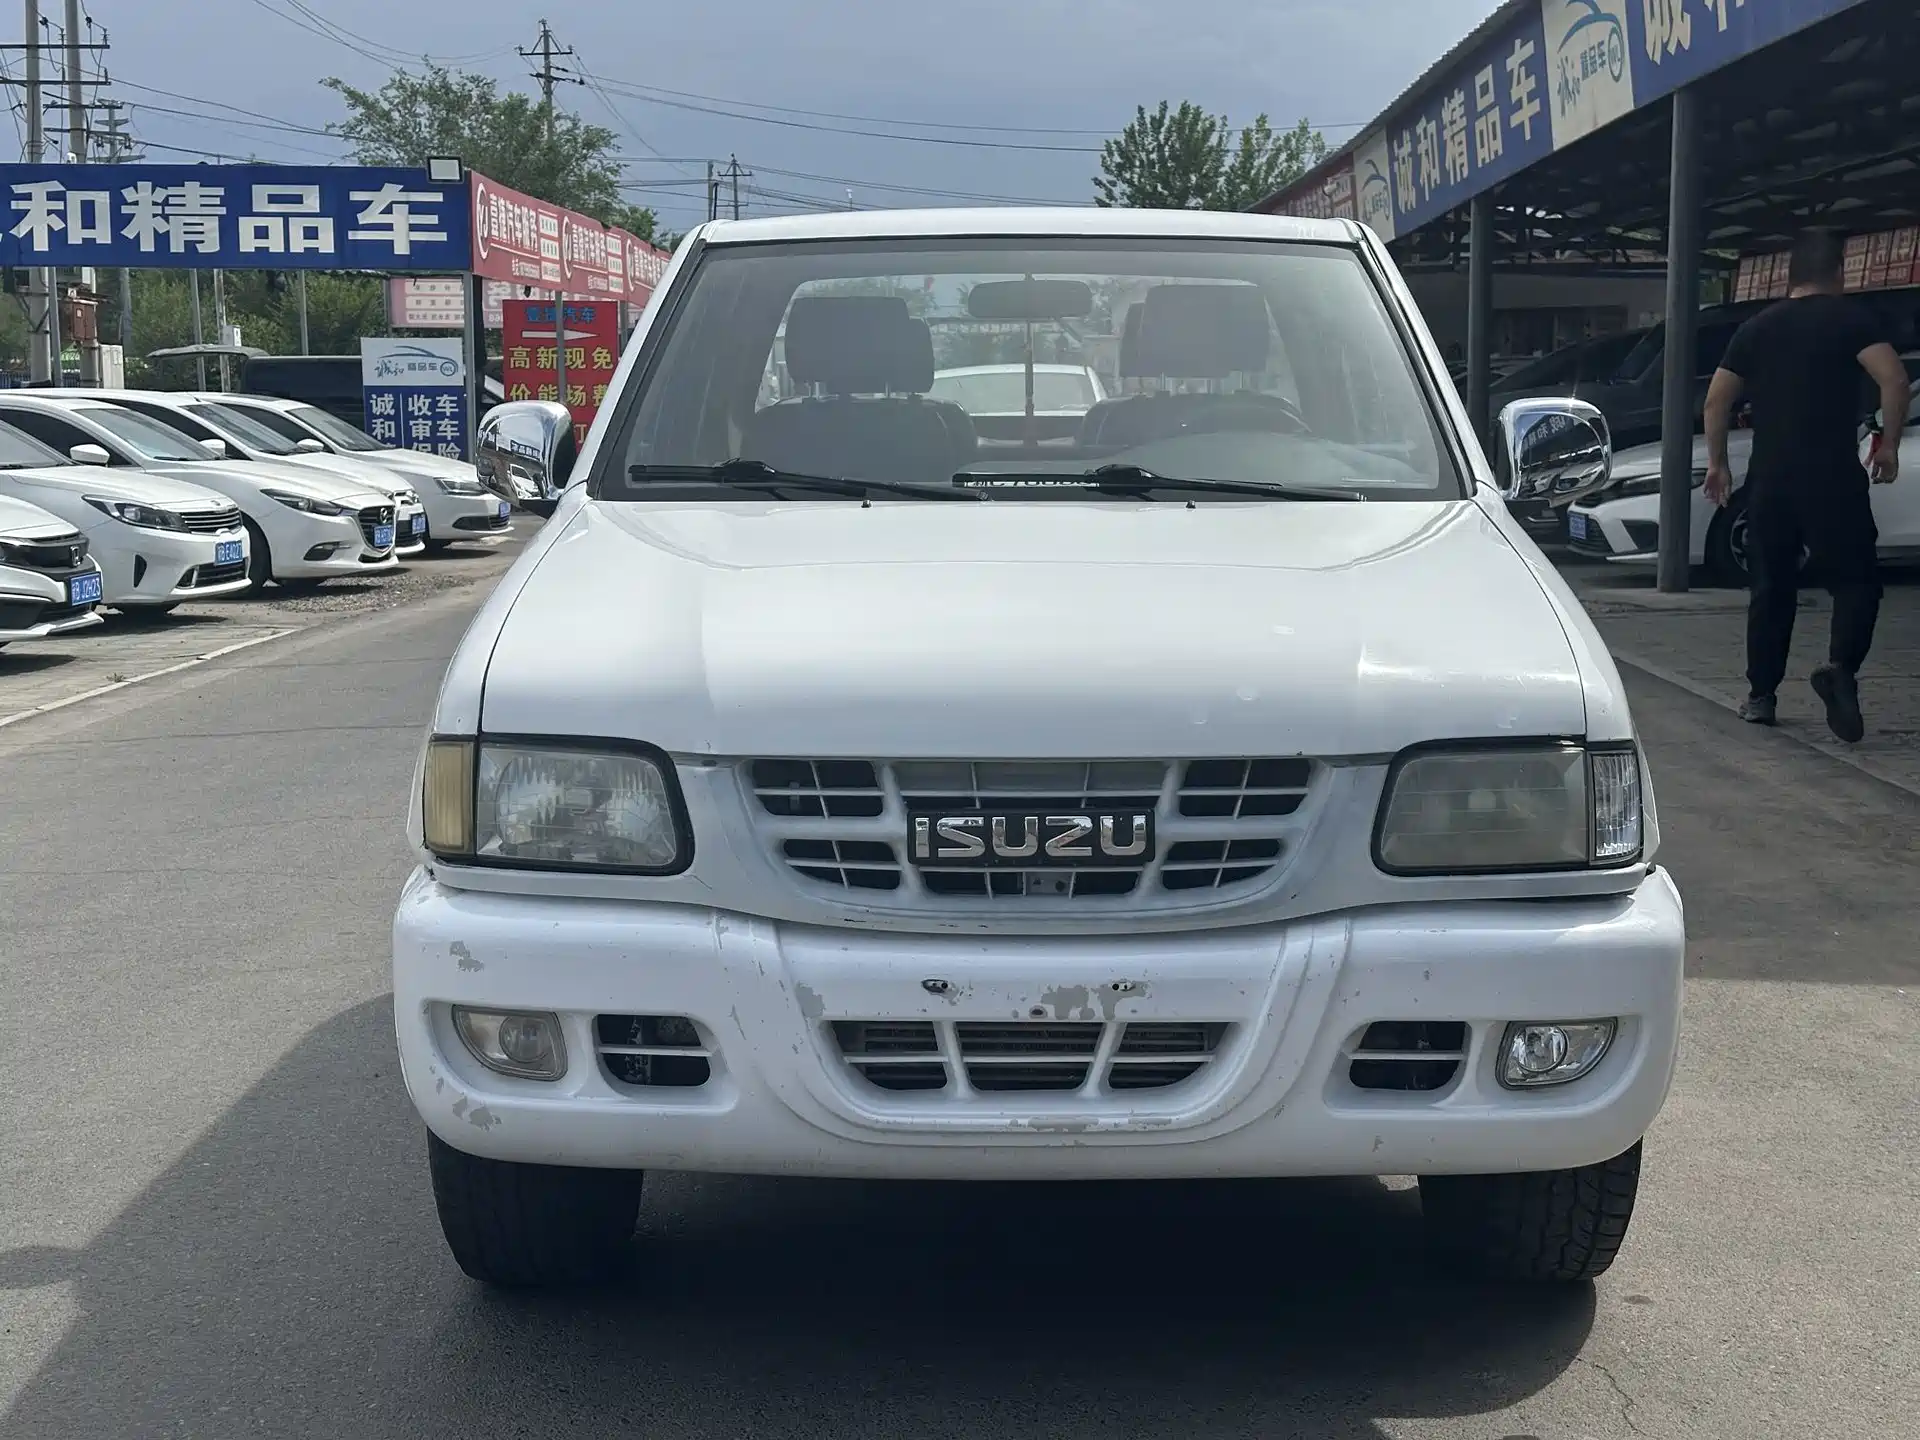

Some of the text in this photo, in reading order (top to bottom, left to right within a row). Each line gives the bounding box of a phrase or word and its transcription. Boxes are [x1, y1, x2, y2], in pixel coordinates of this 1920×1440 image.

[1393, 38, 1541, 214] 诚和精品车
[0, 180, 448, 254] 和精品车
[370, 393, 396, 448] 诚和
[915, 815, 1147, 858] ISUZU
